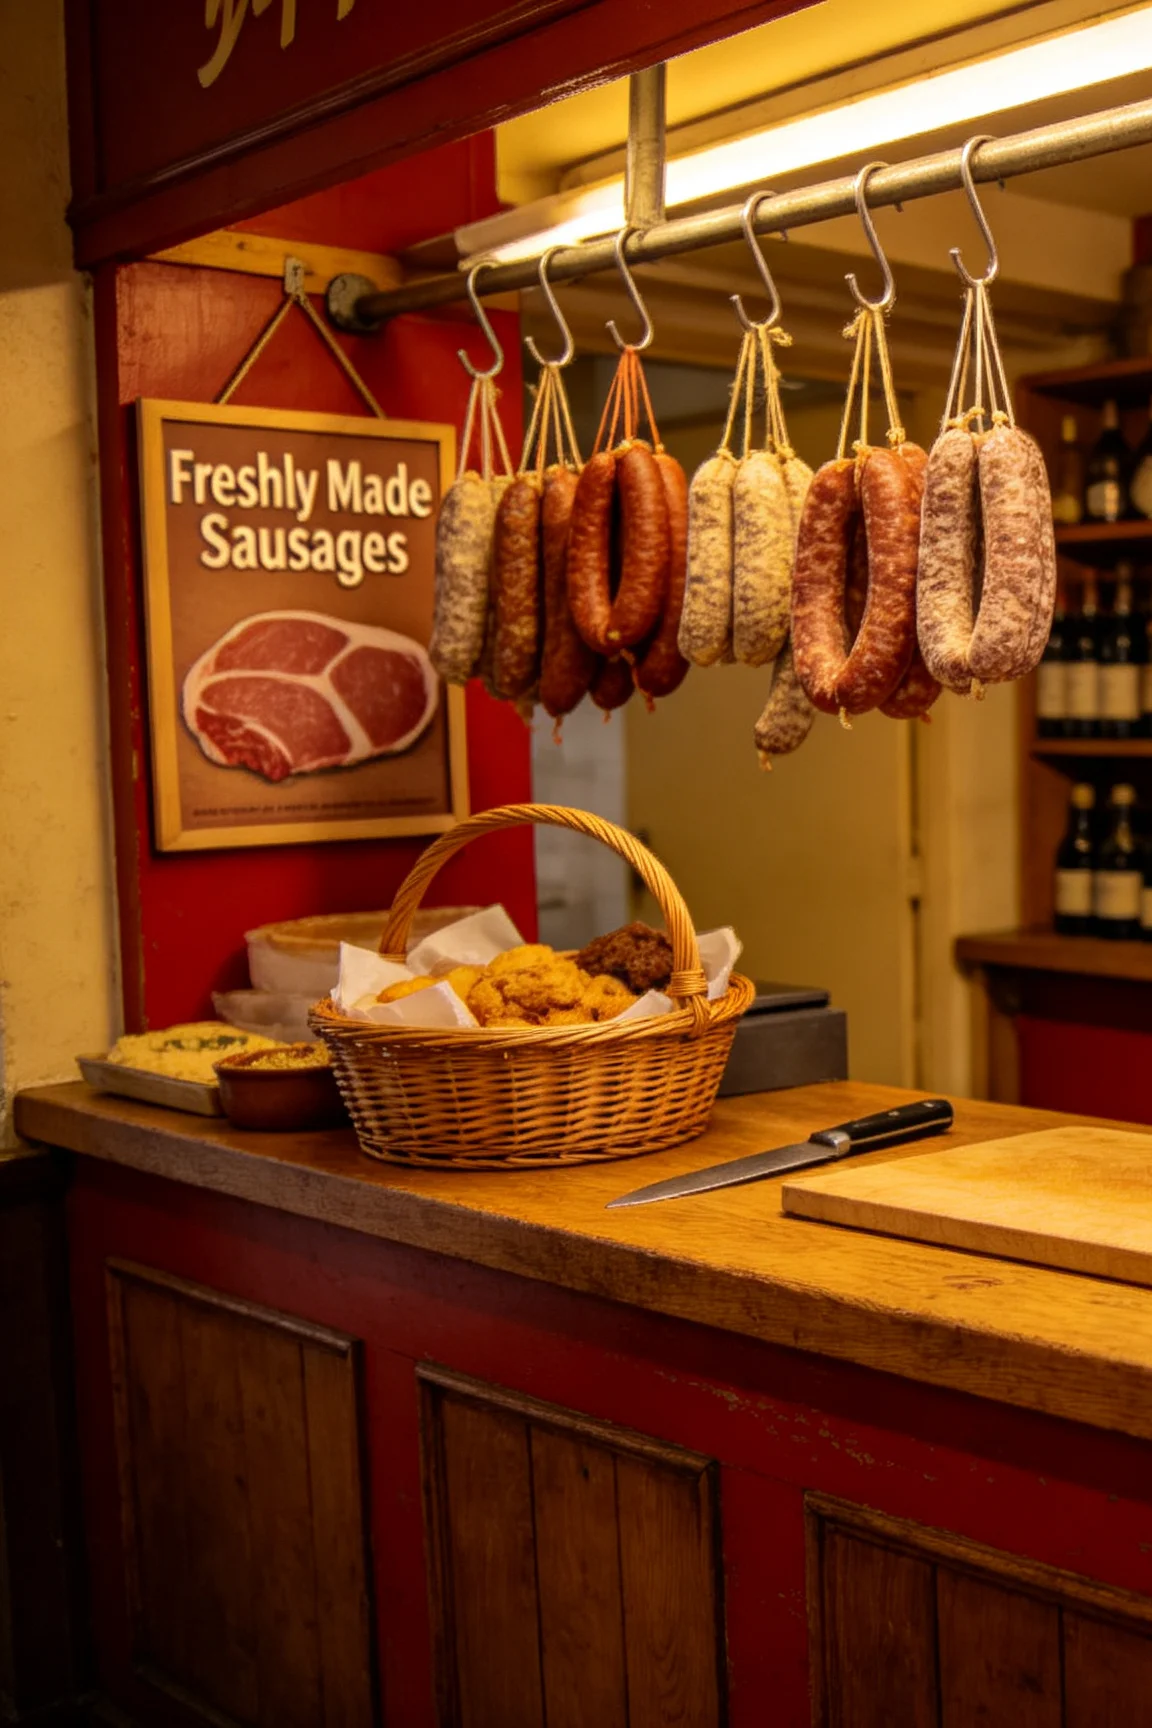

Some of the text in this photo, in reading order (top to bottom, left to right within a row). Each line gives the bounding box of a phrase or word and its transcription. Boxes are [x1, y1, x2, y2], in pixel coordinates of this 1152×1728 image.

[170, 449, 433, 522] Freshly Made
[200, 512, 409, 587] Sausages
